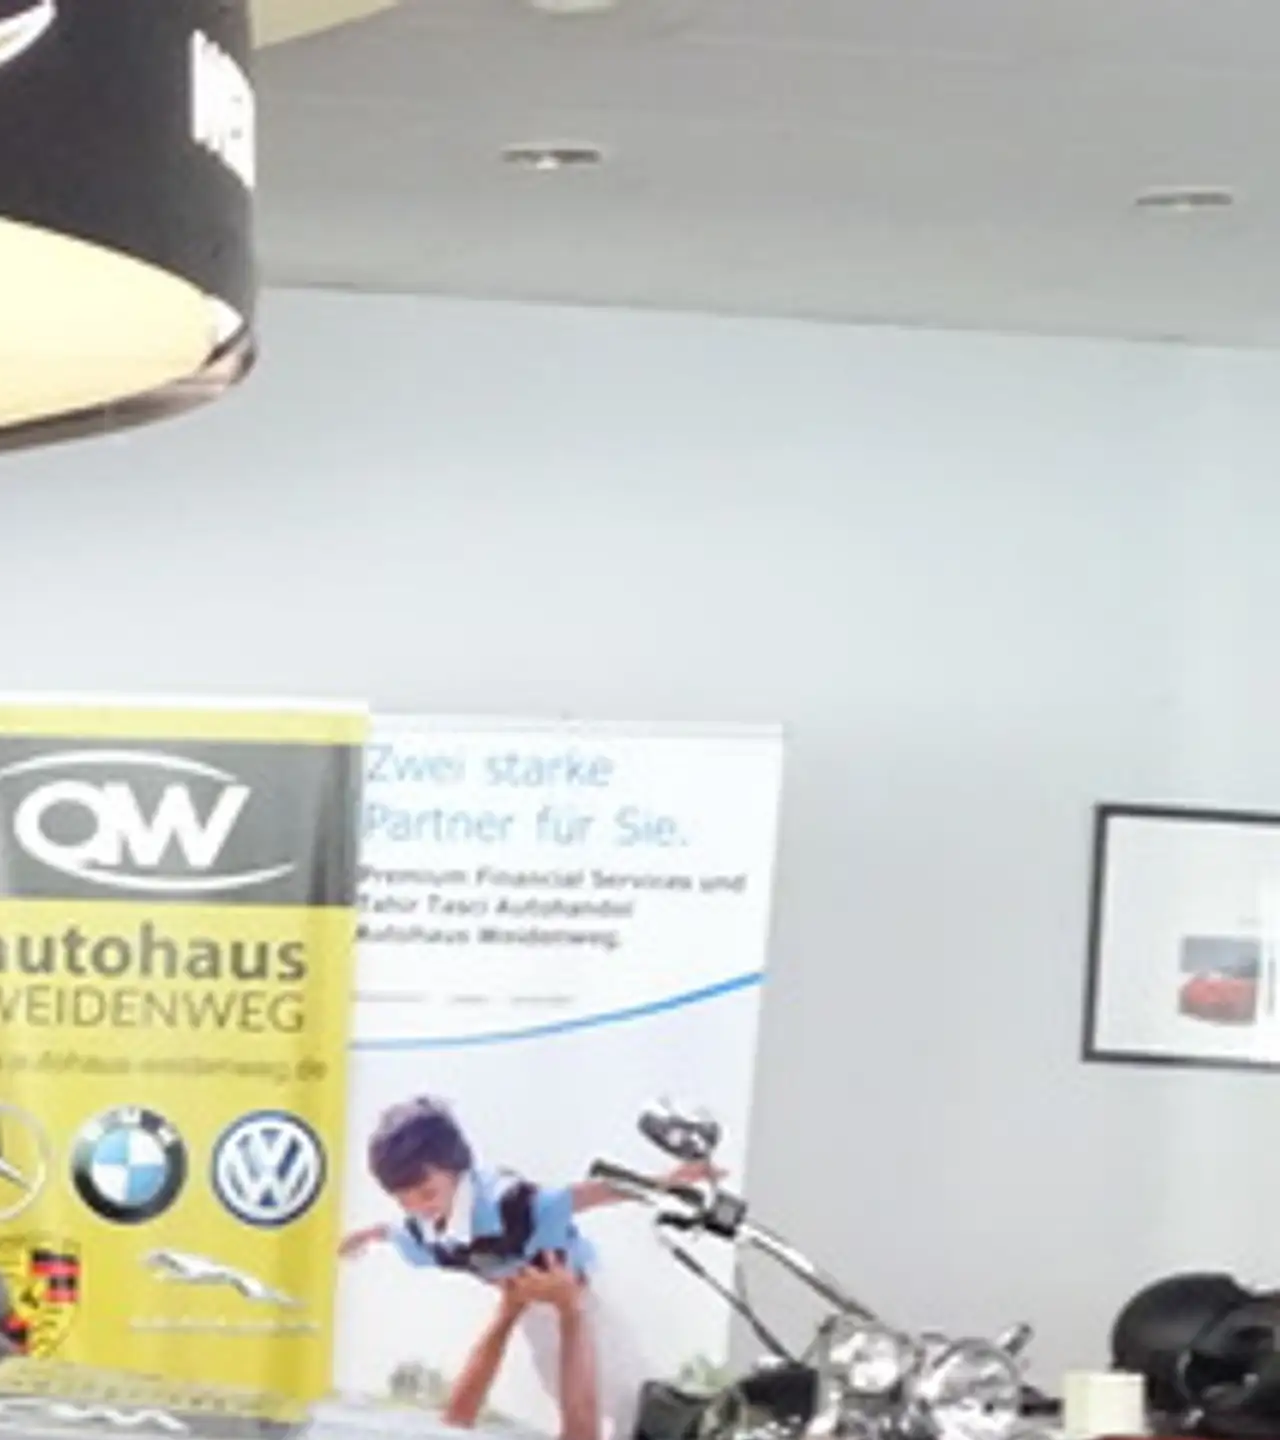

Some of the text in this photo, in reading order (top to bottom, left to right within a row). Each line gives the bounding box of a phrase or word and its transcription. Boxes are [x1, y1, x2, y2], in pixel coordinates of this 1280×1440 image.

[366, 744, 614, 787] Zwei starke
[361, 804, 689, 847] Partner für Sie.
[357, 863, 747, 893] Premium Financial Services und
